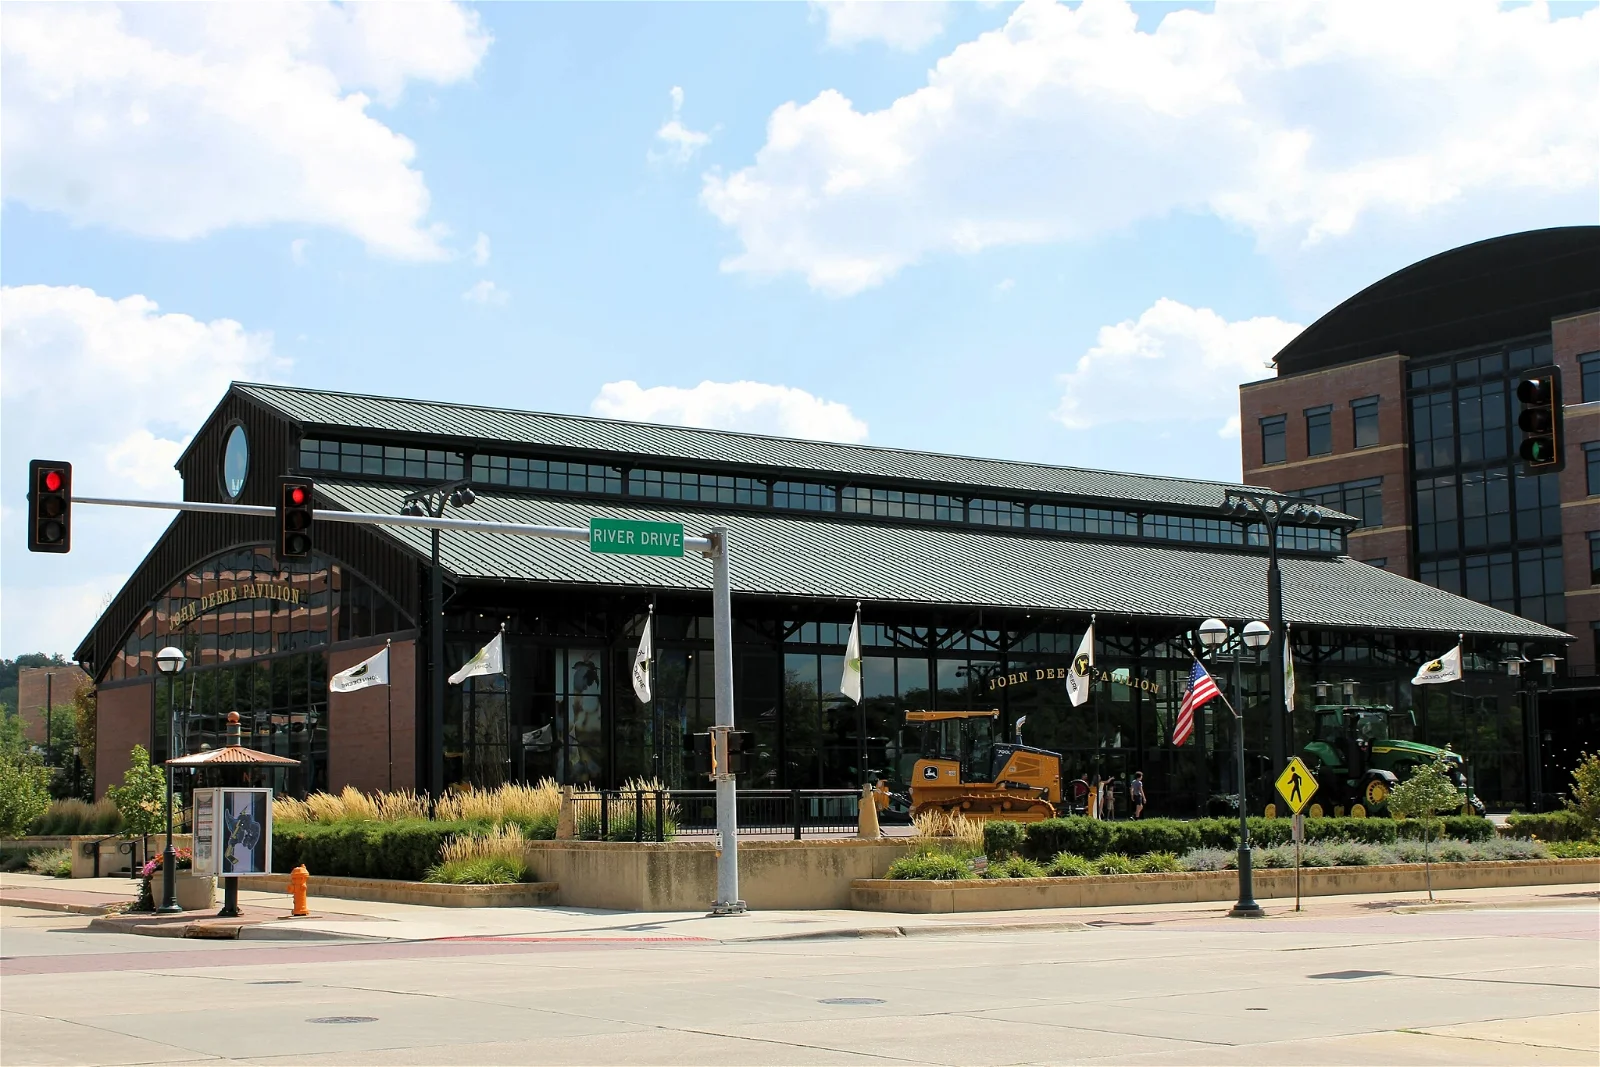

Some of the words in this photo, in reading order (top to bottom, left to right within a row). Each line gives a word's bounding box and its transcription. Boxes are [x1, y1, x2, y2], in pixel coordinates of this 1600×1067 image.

[593, 528, 635, 544] RIVER
[641, 531, 680, 547] DRIVE
[169, 601, 196, 630] JOHN
[201, 586, 237, 611] DEERE
[243, 583, 300, 605] PAVILION
[989, 671, 1028, 691] JOHN
[1036, 668, 1070, 680] DEE
